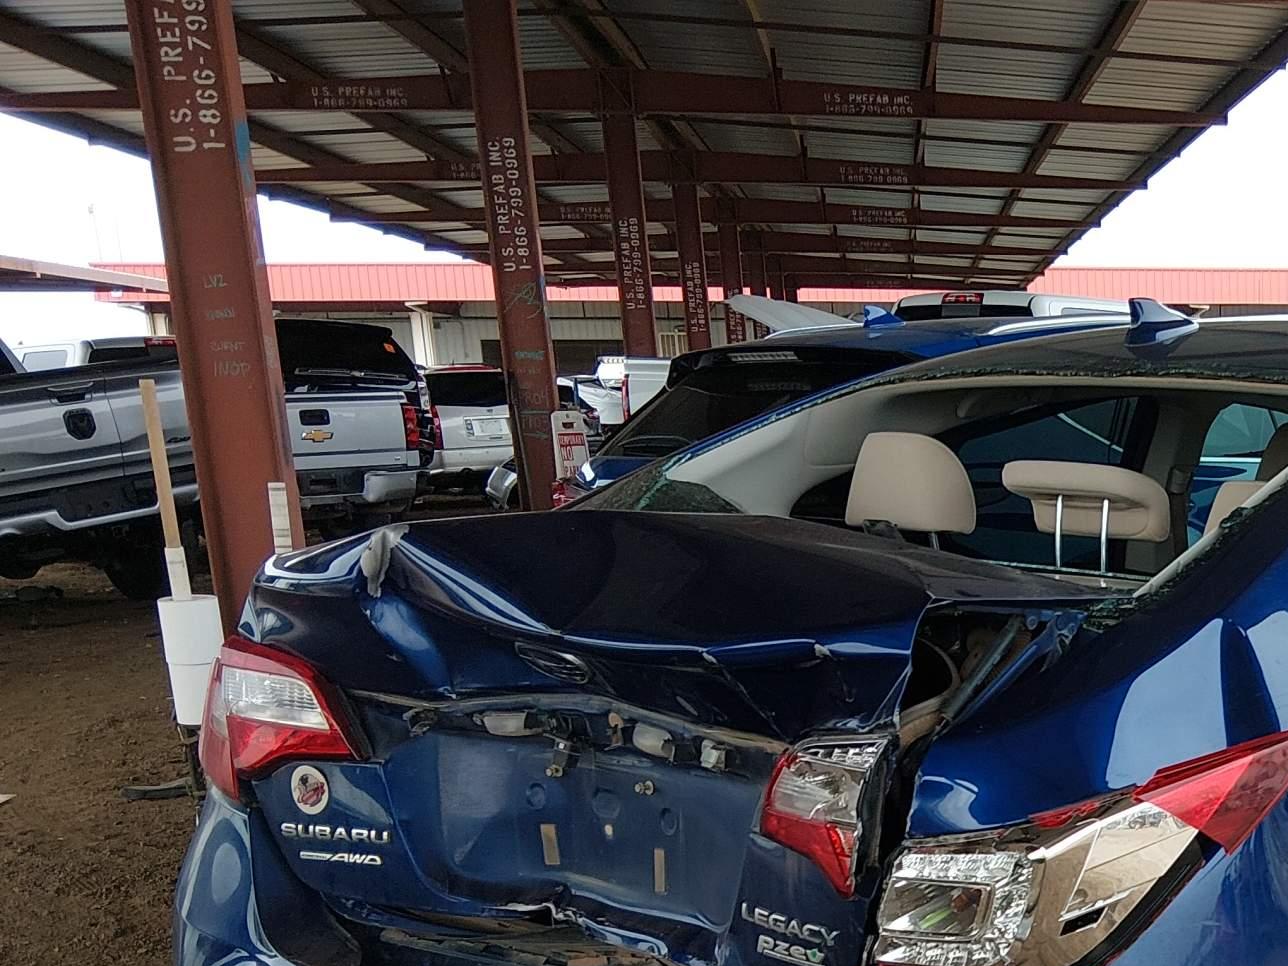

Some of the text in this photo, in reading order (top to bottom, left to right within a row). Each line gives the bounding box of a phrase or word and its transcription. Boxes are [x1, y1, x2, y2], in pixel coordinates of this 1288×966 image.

[153, 0, 197, 152] U.S. PREF
[487, 136, 516, 272] U.S. PREFAB INC.
[502, 137, 532, 269] 1-866-799-0969
[621, 243, 634, 284] PREFAB
[561, 446, 574, 460] NO
[281, 823, 391, 844] SUBARU
[329, 853, 382, 865] AWD
[741, 902, 840, 946] LEGACY
